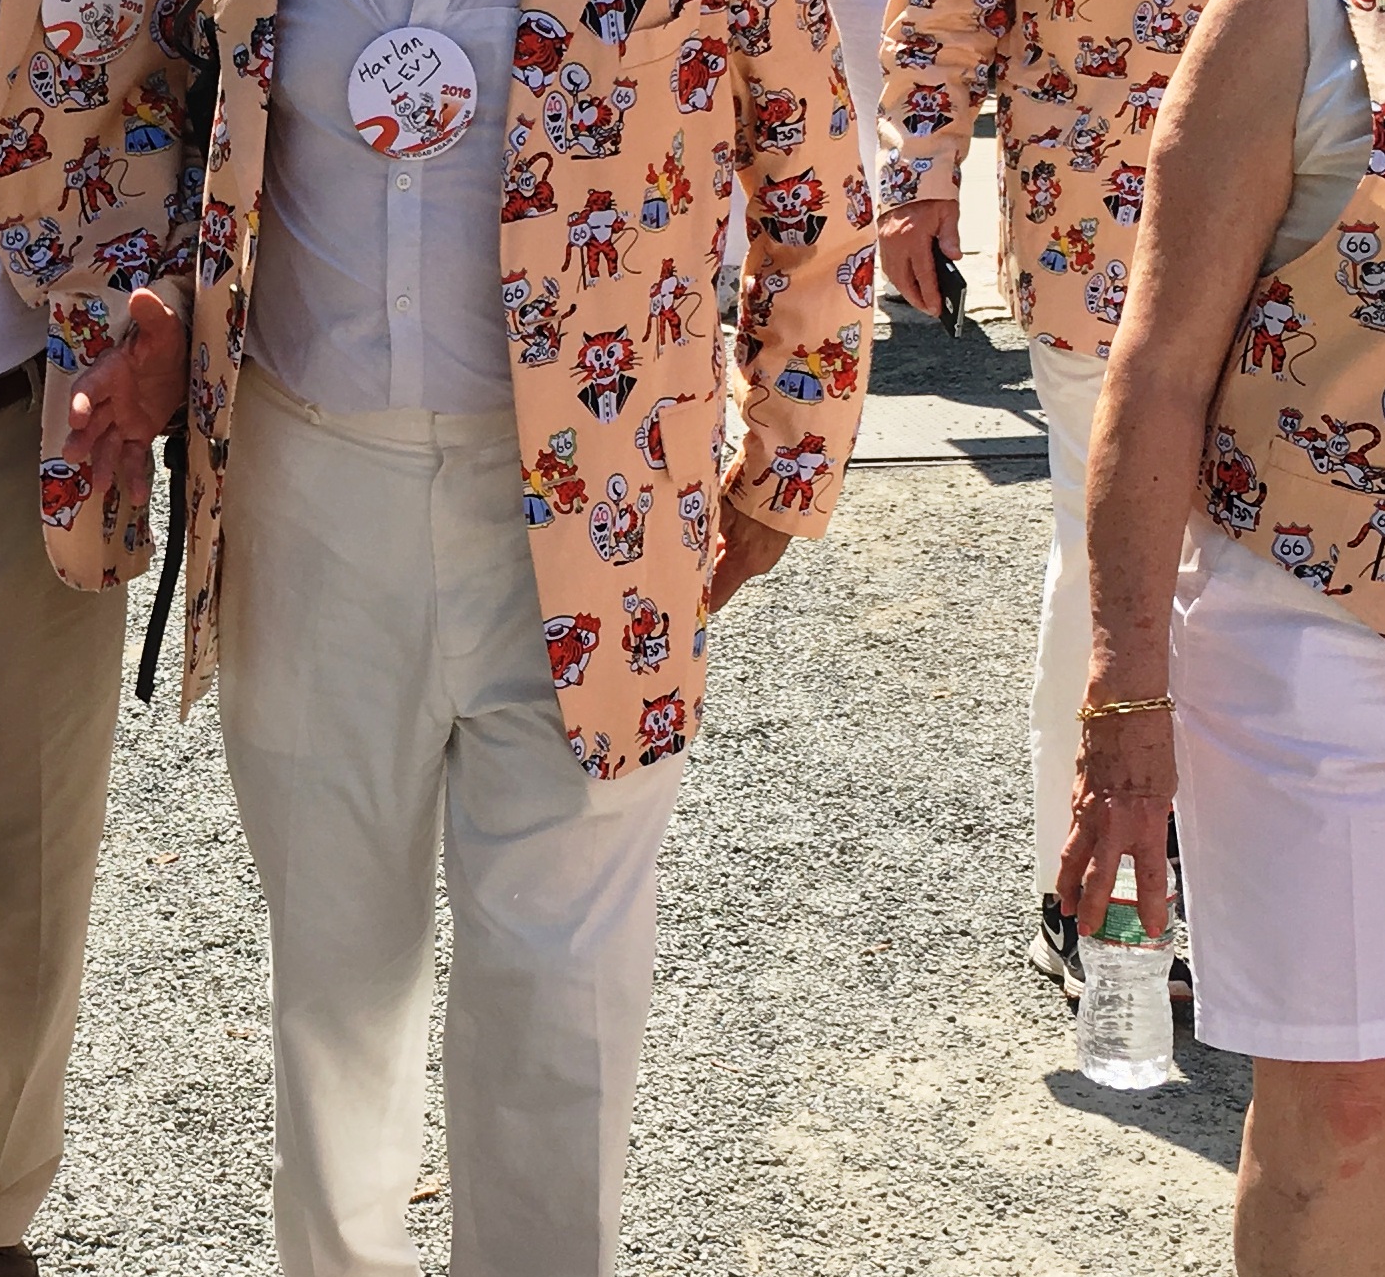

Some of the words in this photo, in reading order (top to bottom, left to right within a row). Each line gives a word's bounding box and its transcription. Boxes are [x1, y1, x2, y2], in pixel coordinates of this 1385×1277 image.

[32, 59, 48, 71] 40
[358, 37, 423, 83] Harlan
[440, 84, 472, 99] 2016
[616, 91, 631, 103] 66
[1131, 94, 1144, 103] 66
[398, 103, 411, 113] 66
[547, 101, 562, 112] 40
[71, 173, 83, 185] 66
[6, 230, 24, 245] 66
[573, 229, 587, 242] 66
[1346, 236, 1371, 253] 66
[504, 285, 524, 303] 66
[845, 330, 858, 345] 66
[535, 348, 547, 358] 50
[557, 438, 572, 453] 66
[1219, 437, 1230, 448] 66
[777, 460, 793, 473] 66
[684, 497, 699, 514] 66
[594, 511, 608, 523] 40
[1280, 538, 1305, 556] 66
